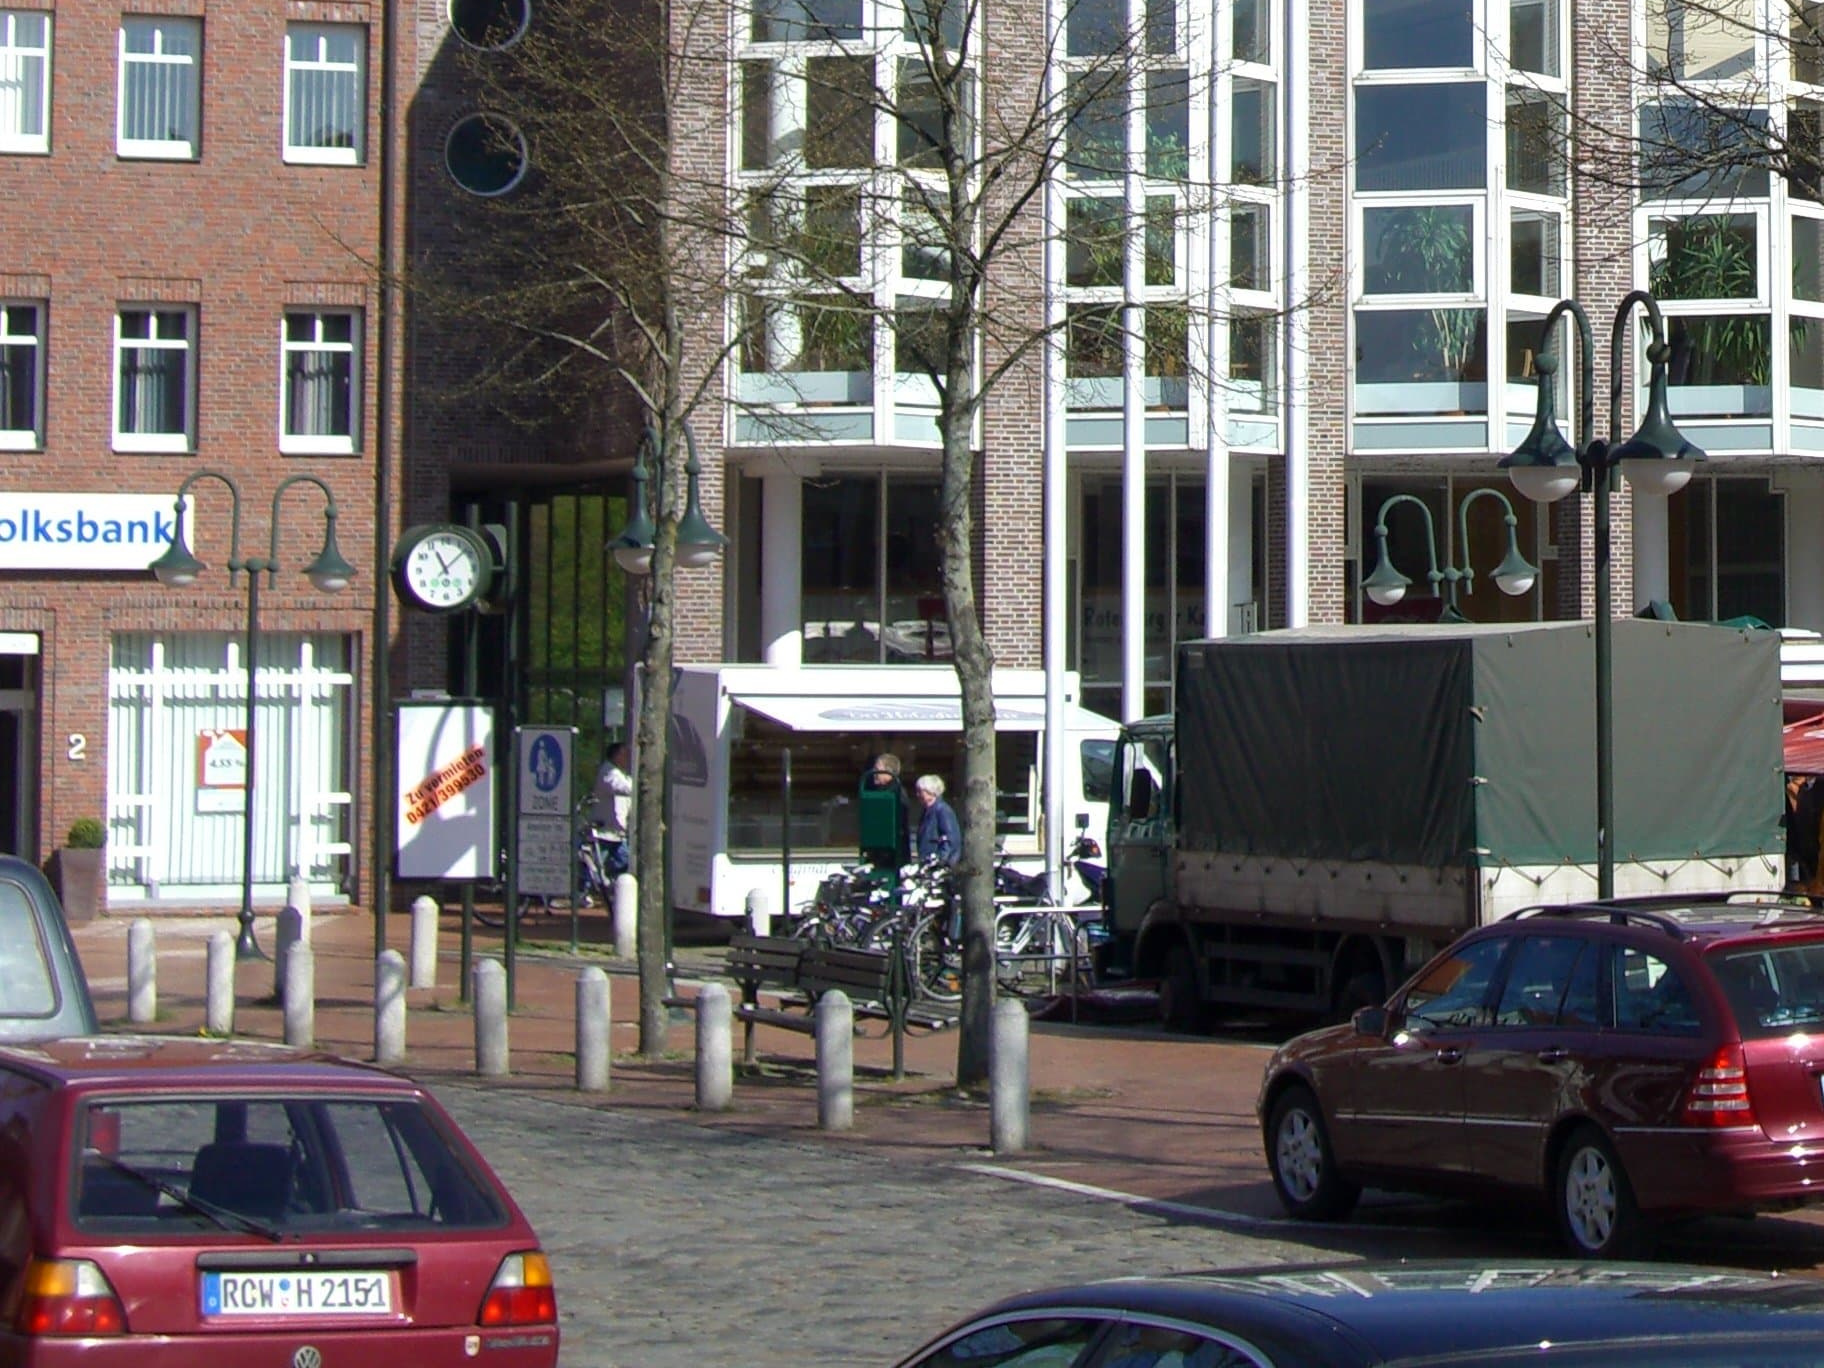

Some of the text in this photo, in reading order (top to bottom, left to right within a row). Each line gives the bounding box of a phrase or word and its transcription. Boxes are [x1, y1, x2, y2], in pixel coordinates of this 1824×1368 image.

[67, 733, 87, 760] 2
[406, 746, 484, 805] Zu vermieten
[533, 795, 558, 811] ZONE
[296, 1278, 313, 1307] H
[320, 1278, 386, 1307] 2151
